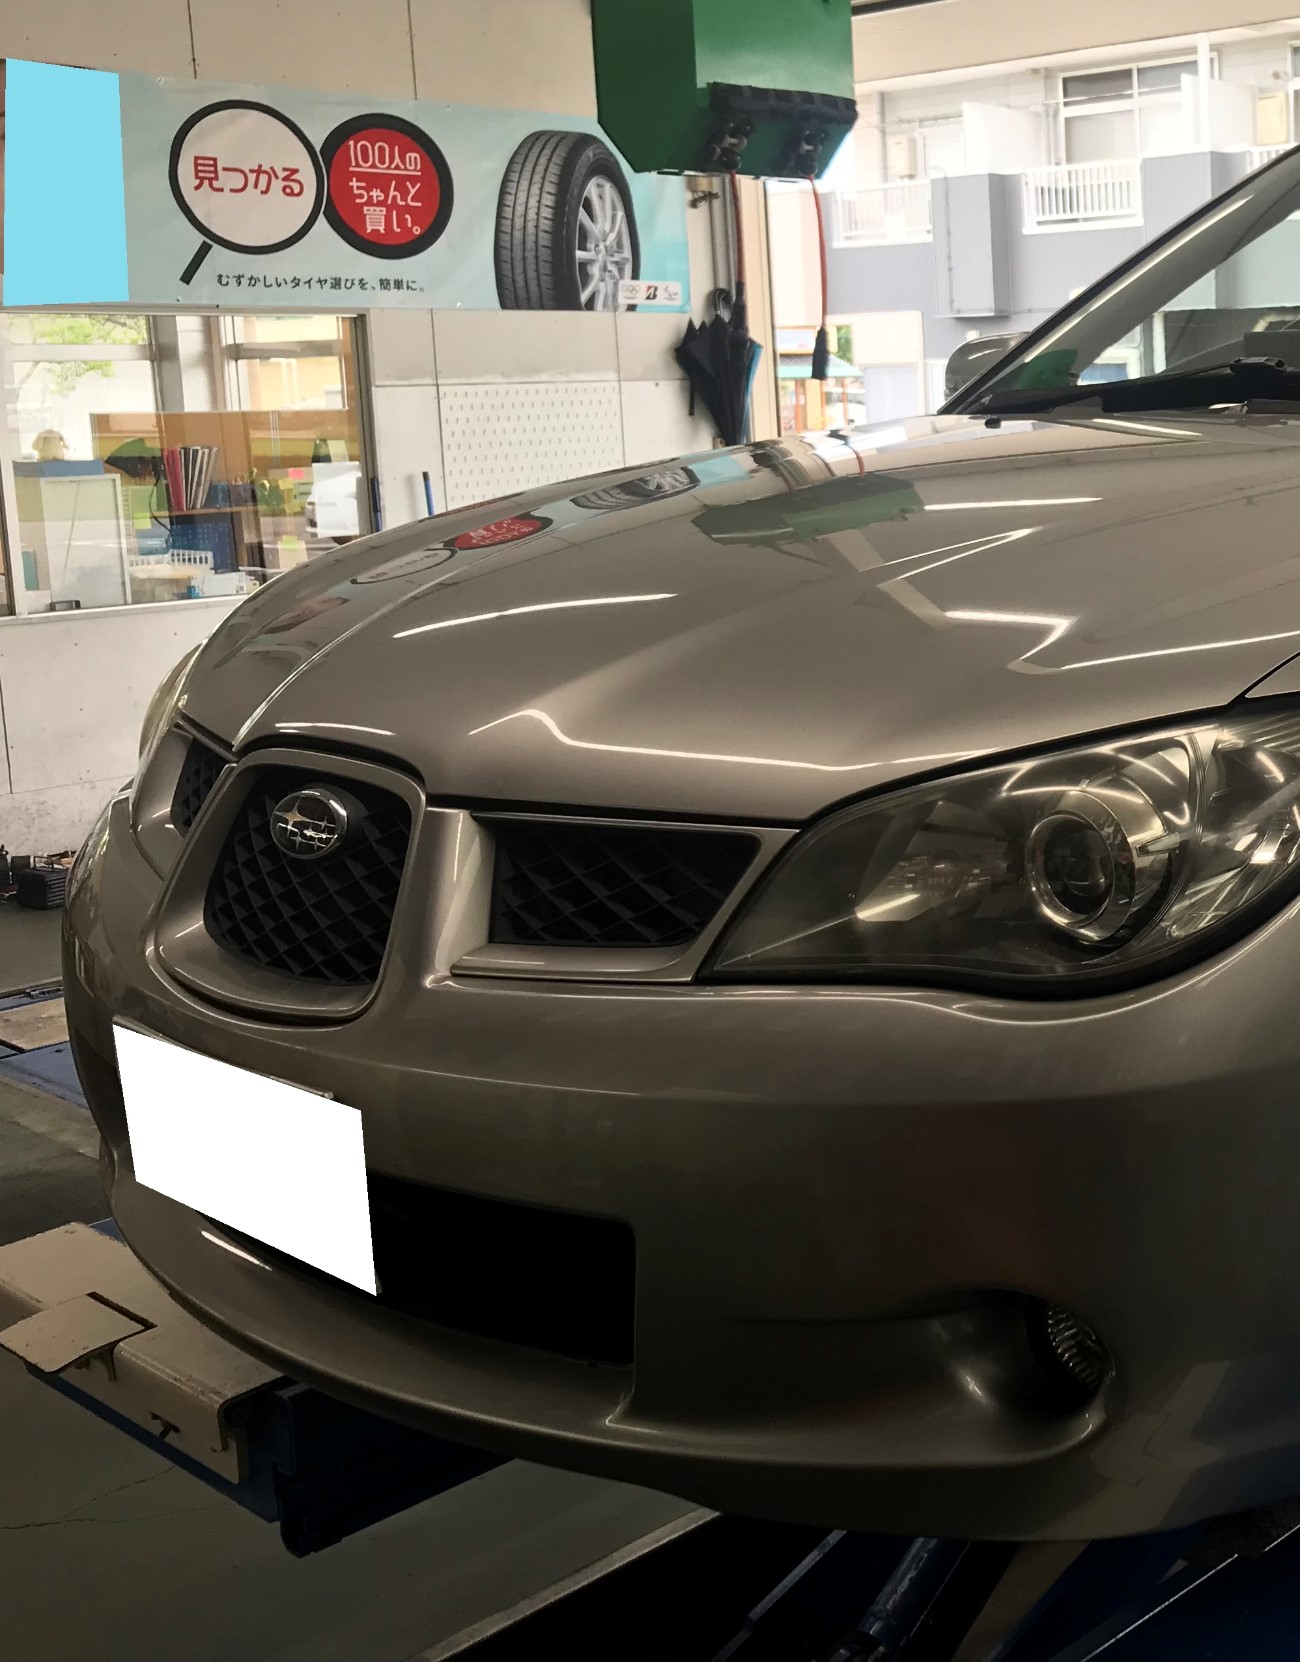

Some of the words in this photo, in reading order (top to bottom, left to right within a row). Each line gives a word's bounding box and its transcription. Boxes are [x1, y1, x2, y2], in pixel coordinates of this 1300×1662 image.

[348, 140, 421, 170] 100人の
[193, 155, 304, 197] 見つかる
[348, 177, 422, 206] ちゃんと
[363, 206, 421, 235] 買い。
[216, 273, 425, 293] むずかしいタイヤ選びを、簡単に。
